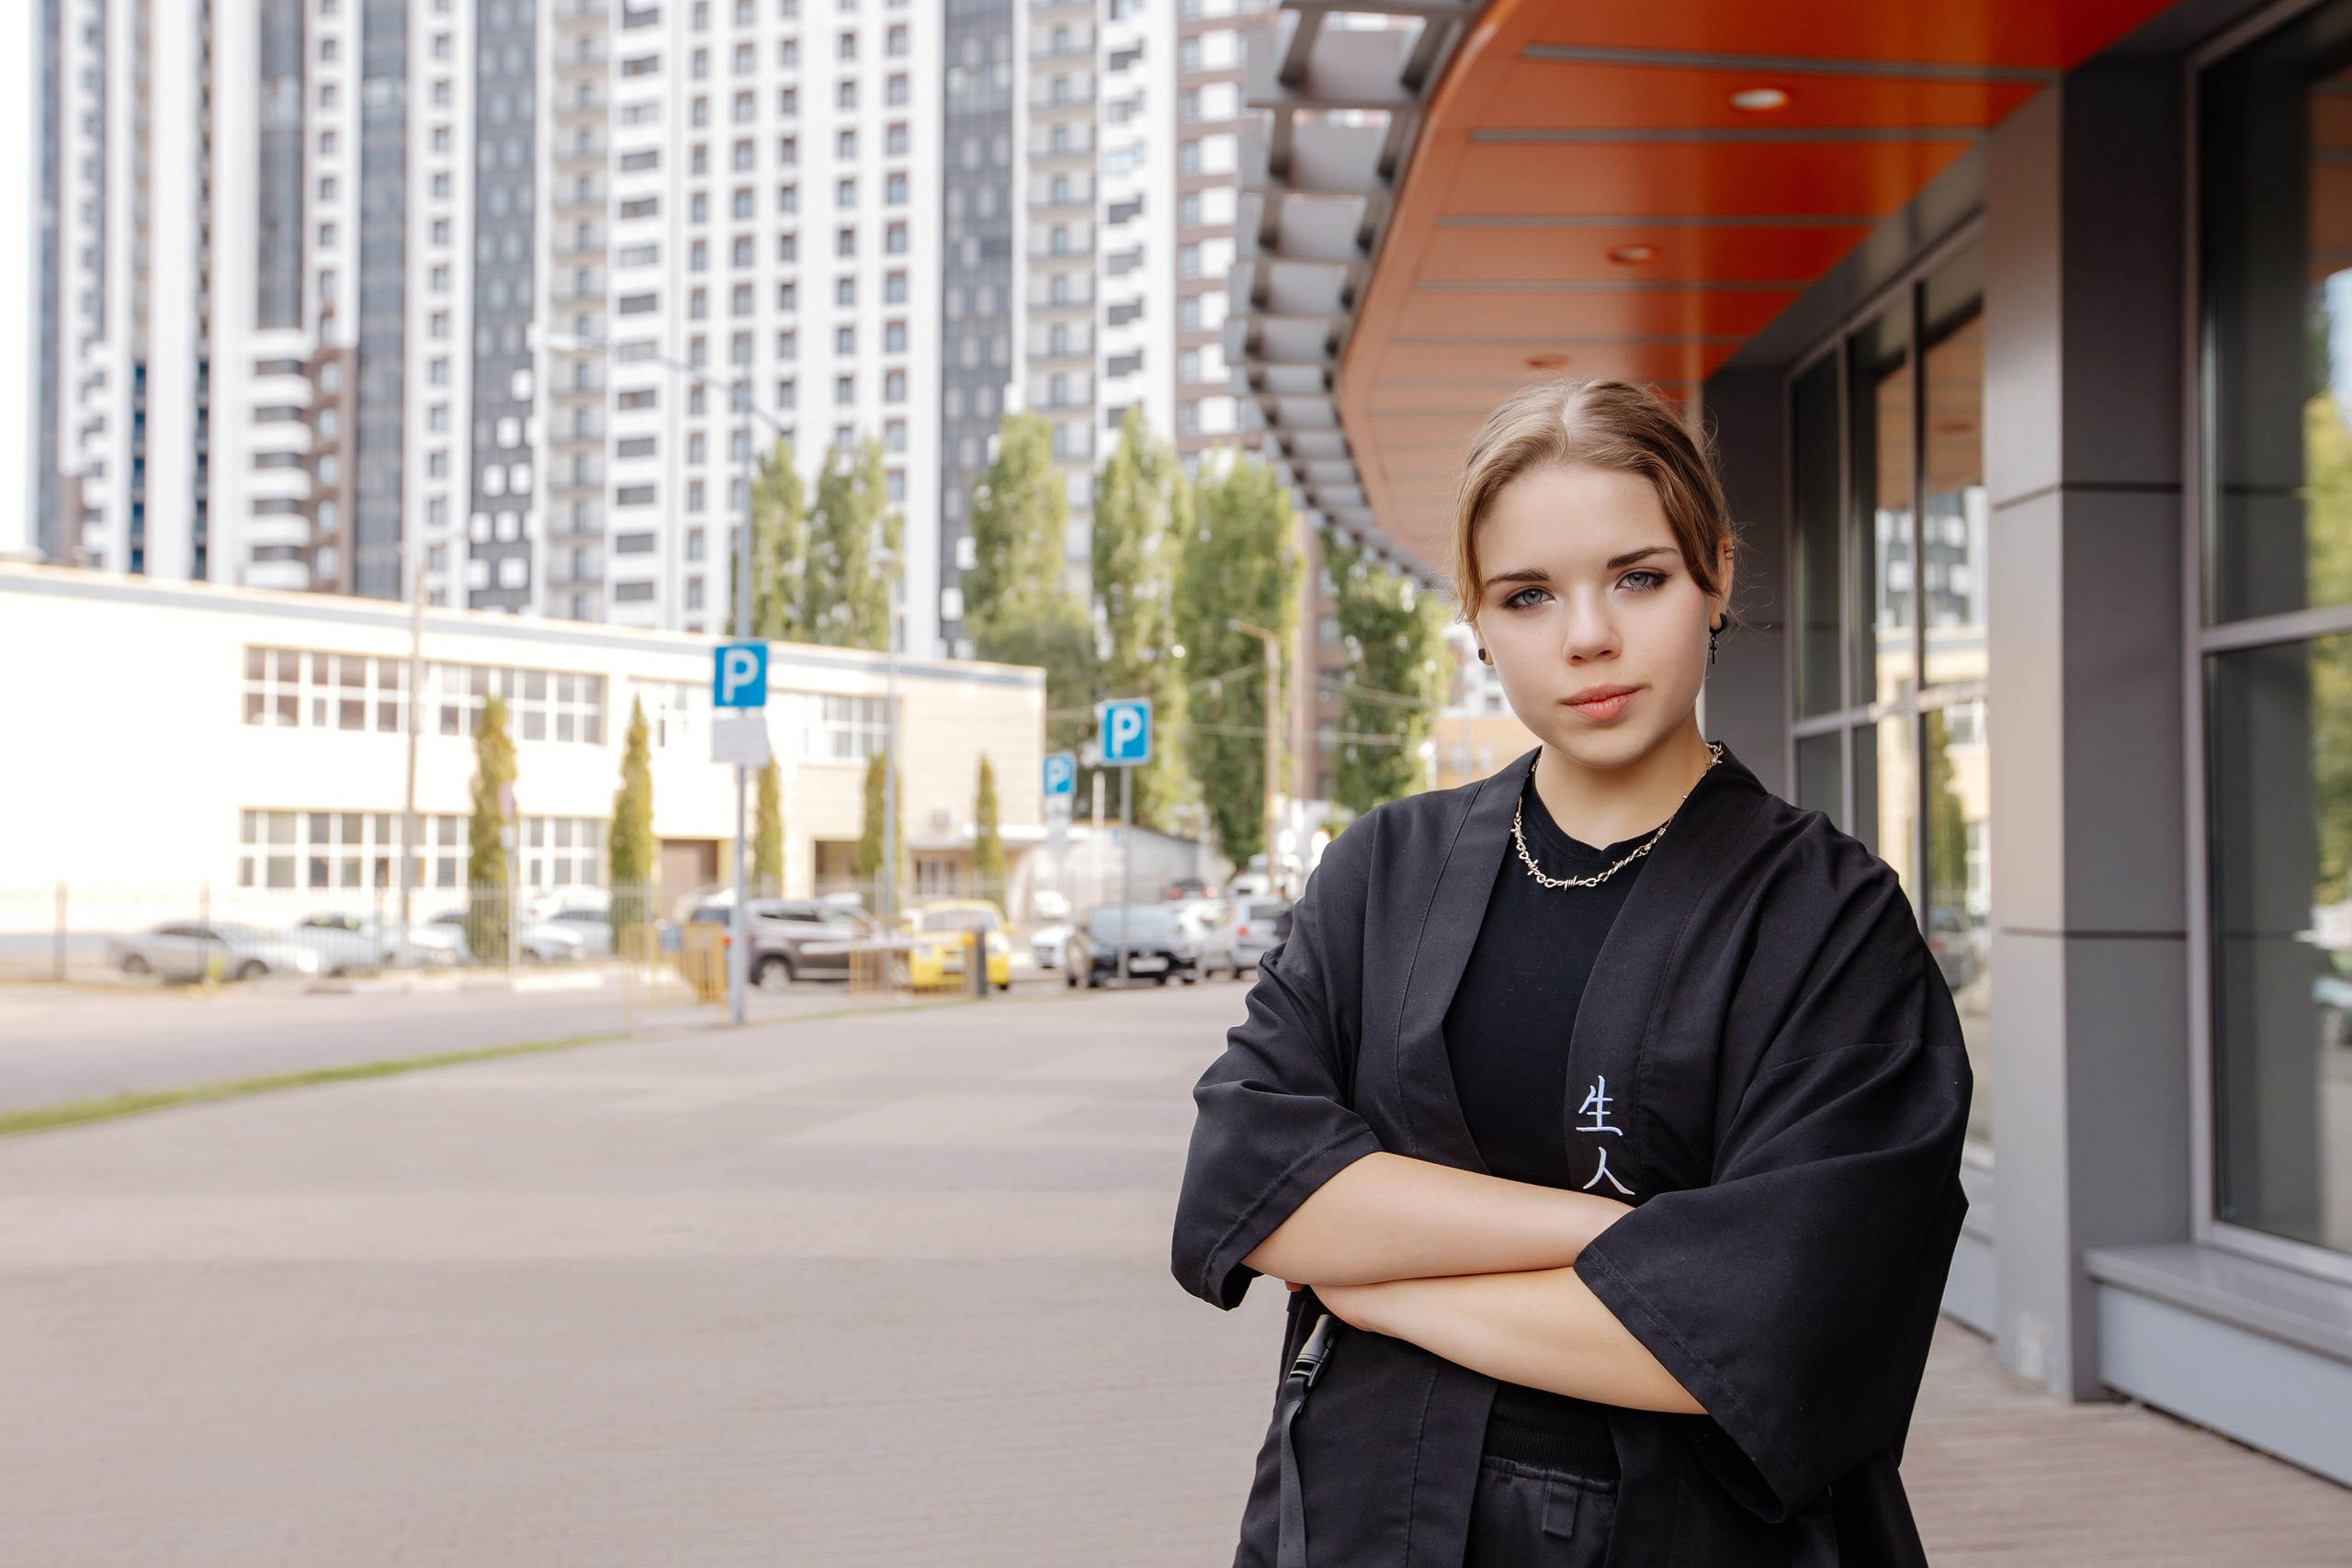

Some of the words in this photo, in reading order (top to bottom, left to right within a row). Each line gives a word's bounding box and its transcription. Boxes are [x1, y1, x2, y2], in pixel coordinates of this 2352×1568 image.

[722, 649, 760, 704] P
[1112, 707, 1142, 756] P
[1046, 757, 1069, 793] P
